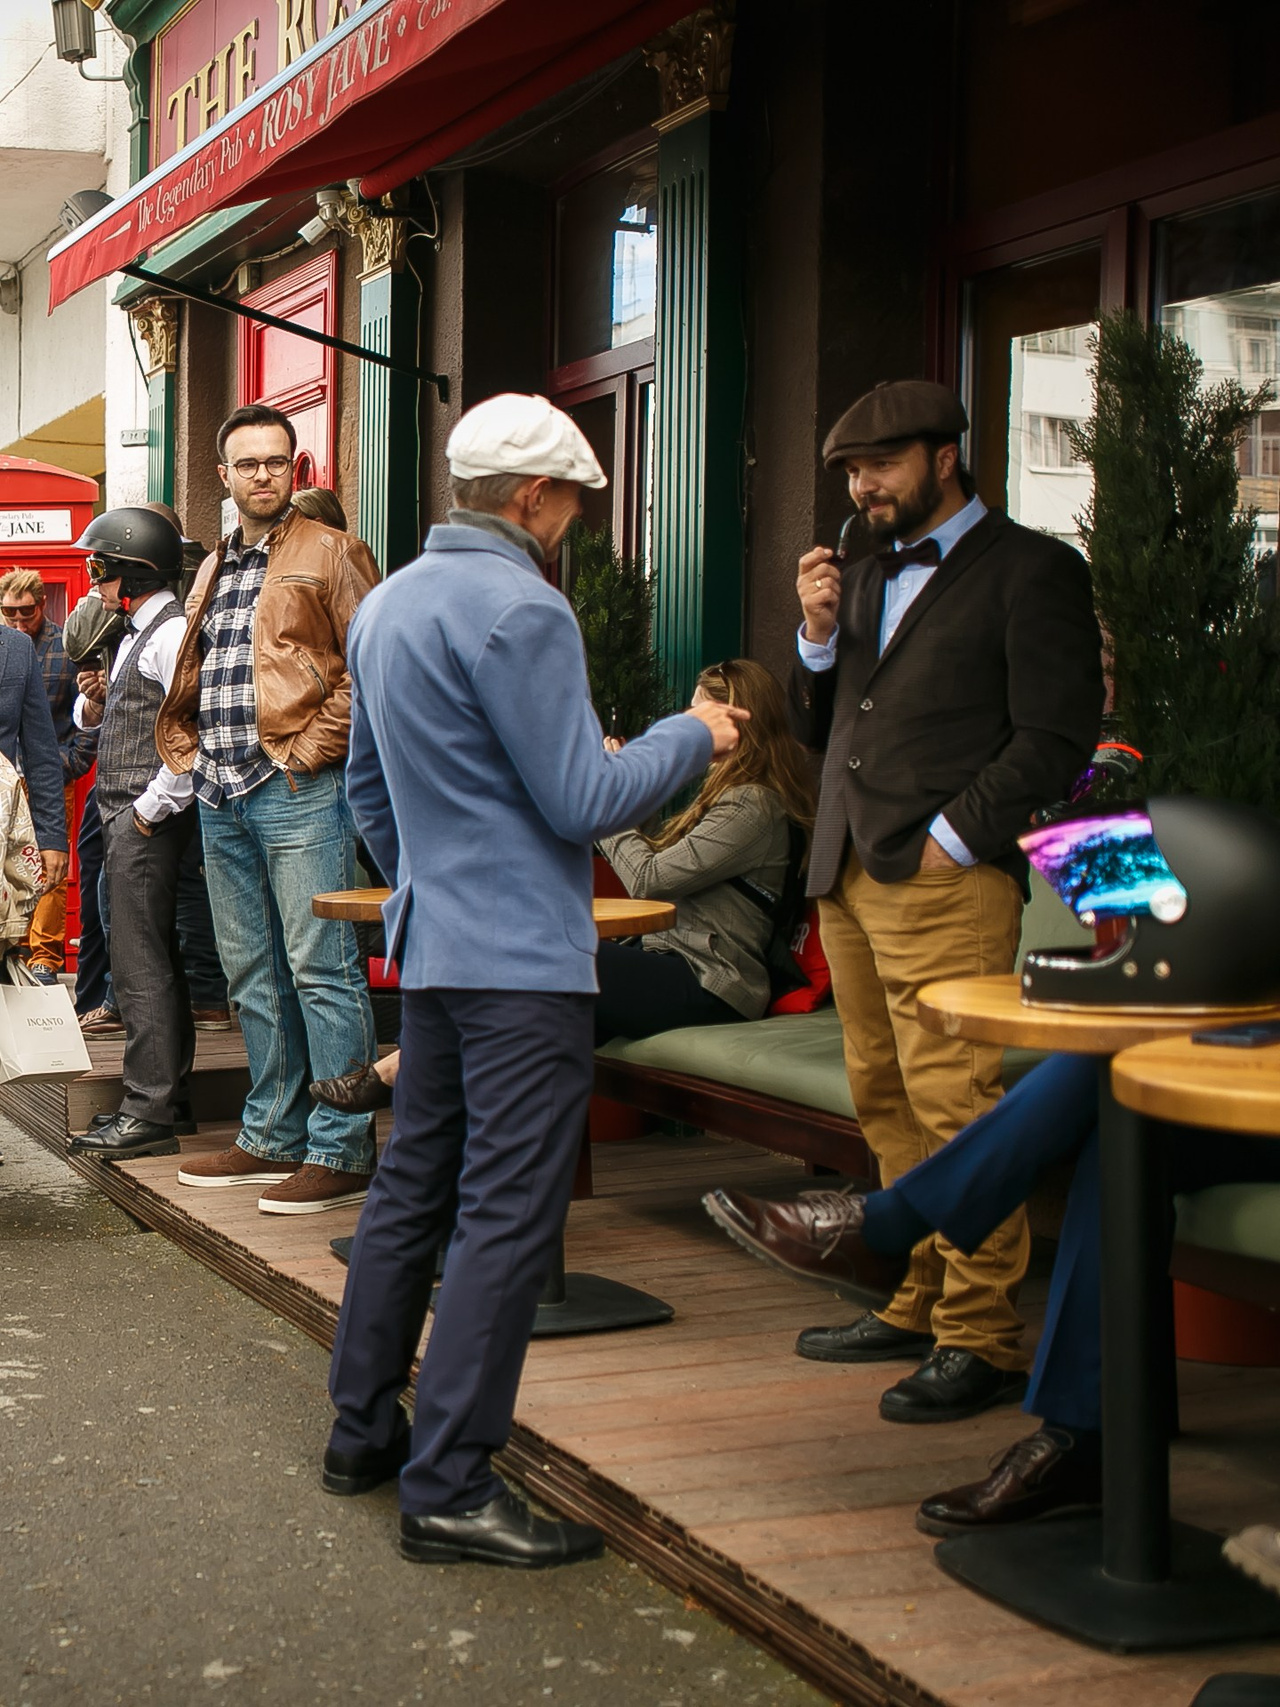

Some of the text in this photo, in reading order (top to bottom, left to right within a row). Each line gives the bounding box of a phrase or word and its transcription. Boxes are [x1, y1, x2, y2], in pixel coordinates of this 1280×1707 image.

[167, 18, 259, 152] THE
[136, 196, 154, 234] The
[155, 157, 218, 224] Legendary
[219, 127, 243, 176] Pub
[258, 59, 324, 154] ROSY
[319, 8, 391, 126] JANE
[7, 521, 45, 538] JANE
[11, 855, 28, 878] STOP
[26, 1017, 64, 1027] INCANTO
